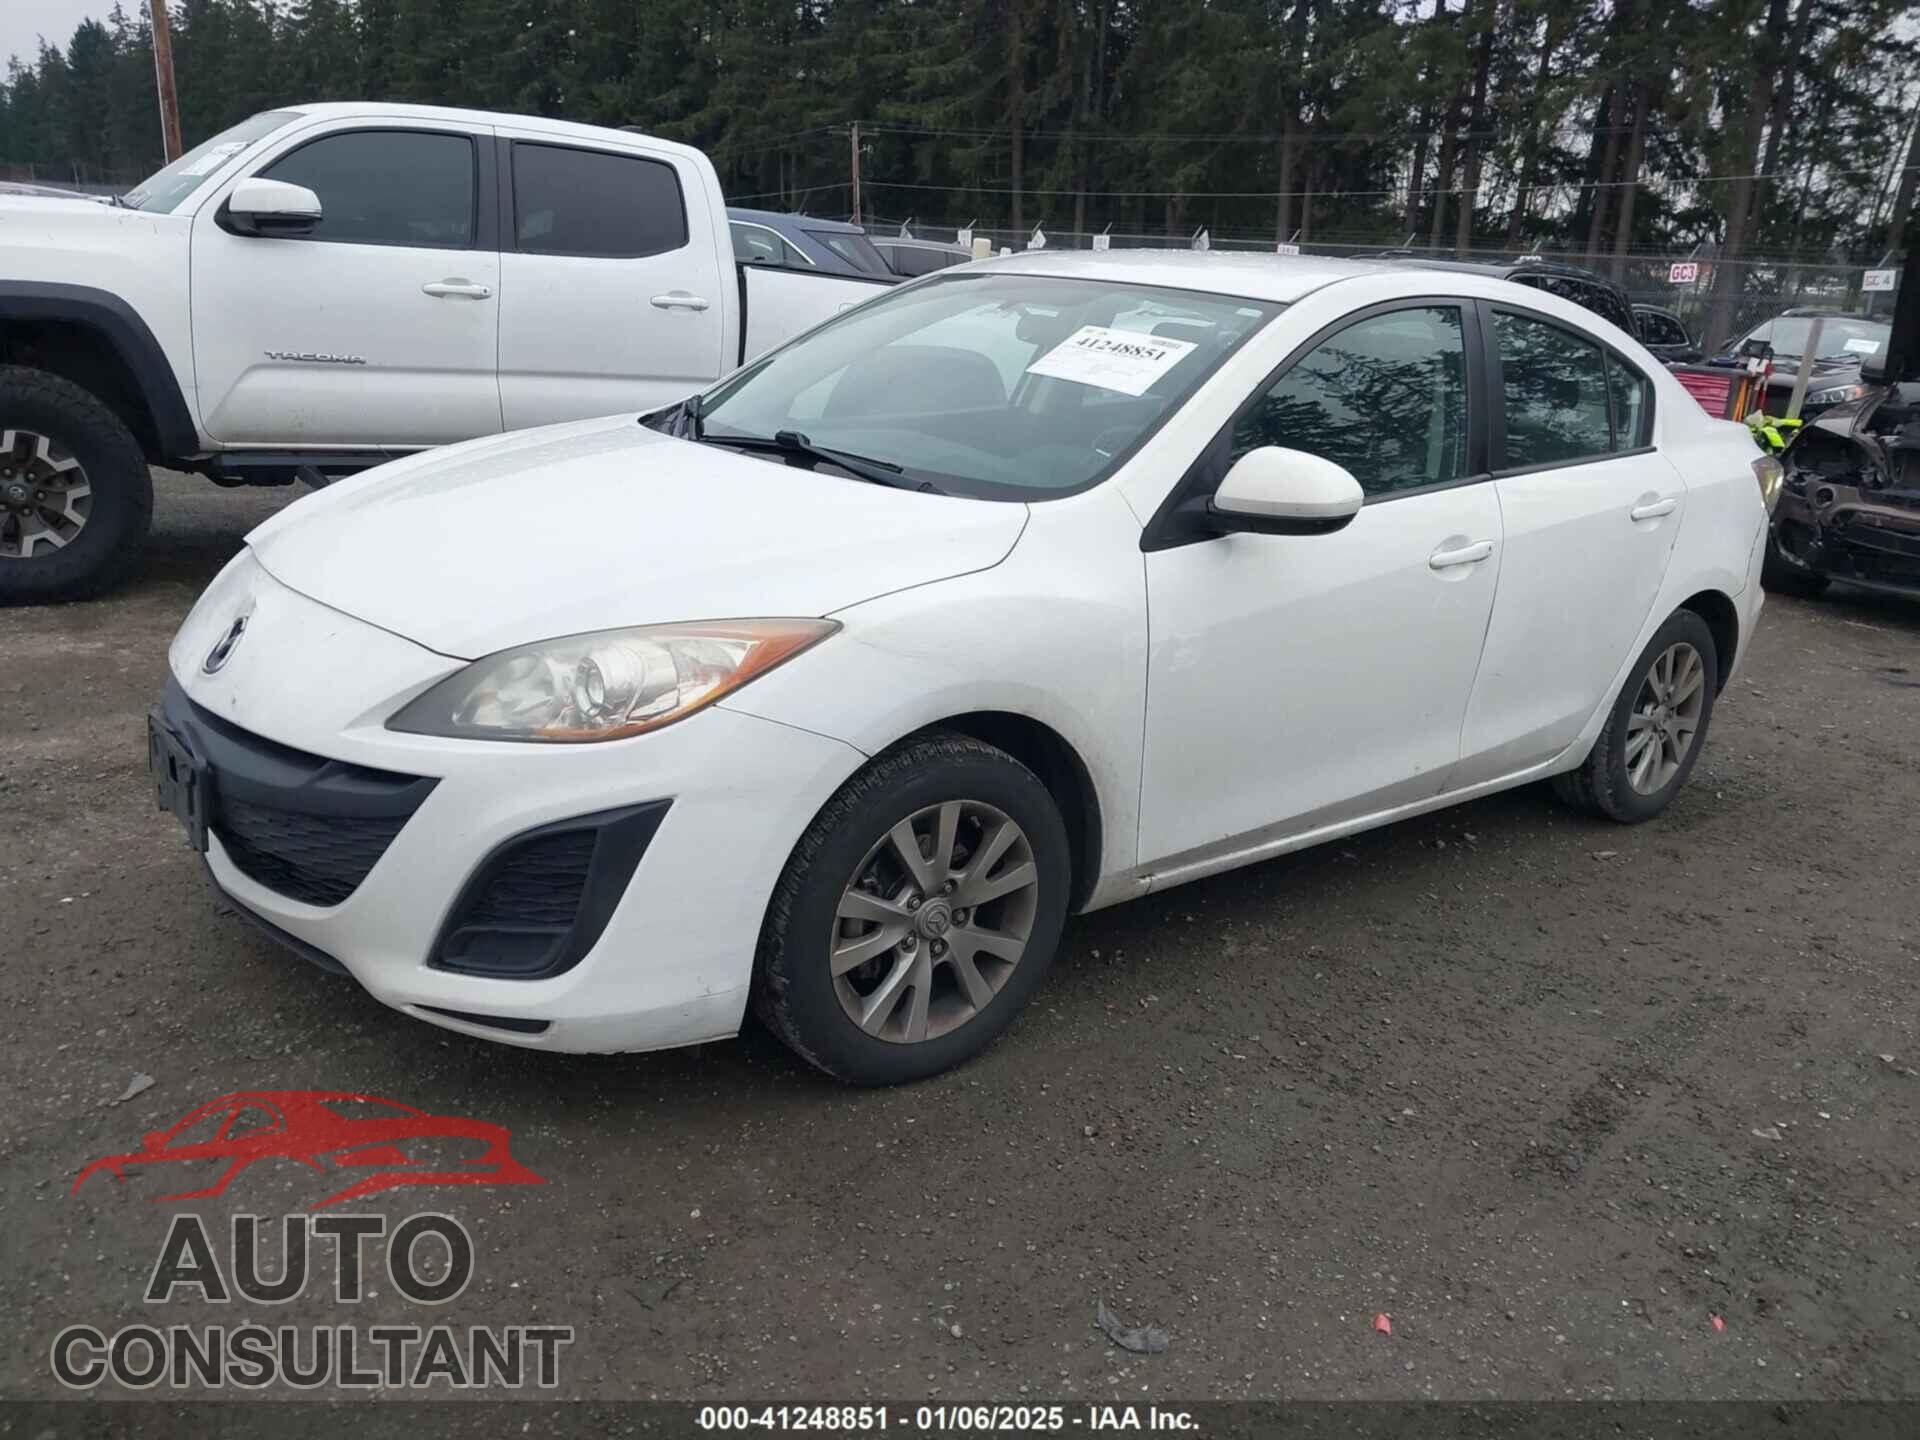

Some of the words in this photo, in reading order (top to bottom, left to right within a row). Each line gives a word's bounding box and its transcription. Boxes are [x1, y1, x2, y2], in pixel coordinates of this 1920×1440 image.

[1672, 265, 1696, 280] GC3
[1076, 337, 1166, 361] 41248851
[263, 350, 367, 365] TACOMA
